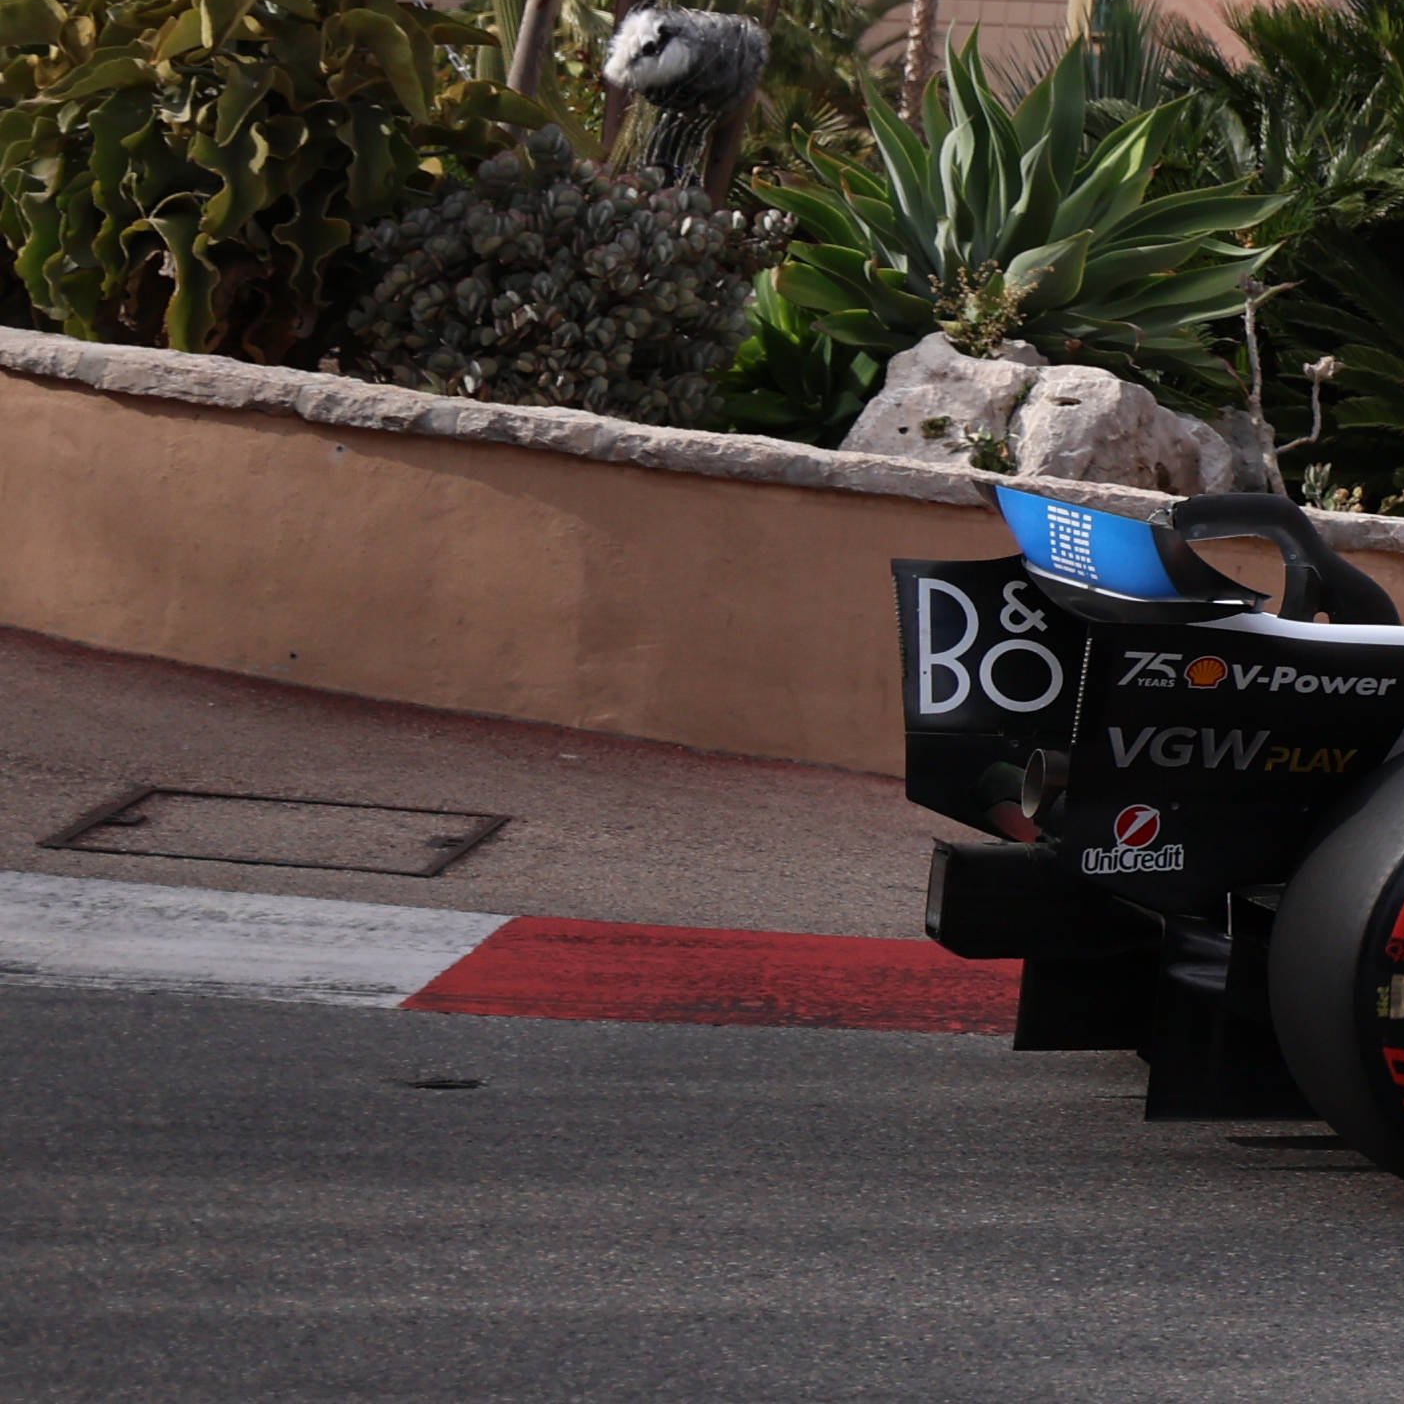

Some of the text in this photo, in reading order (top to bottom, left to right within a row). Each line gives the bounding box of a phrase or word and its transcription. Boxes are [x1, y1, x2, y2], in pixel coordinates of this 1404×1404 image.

[1117, 651, 1397, 696] 75 V-Power
[1137, 677, 1176, 688] YEARS
[1107, 726, 1358, 773] VGW PLAY
[1082, 846, 1184, 873] UniCredit
